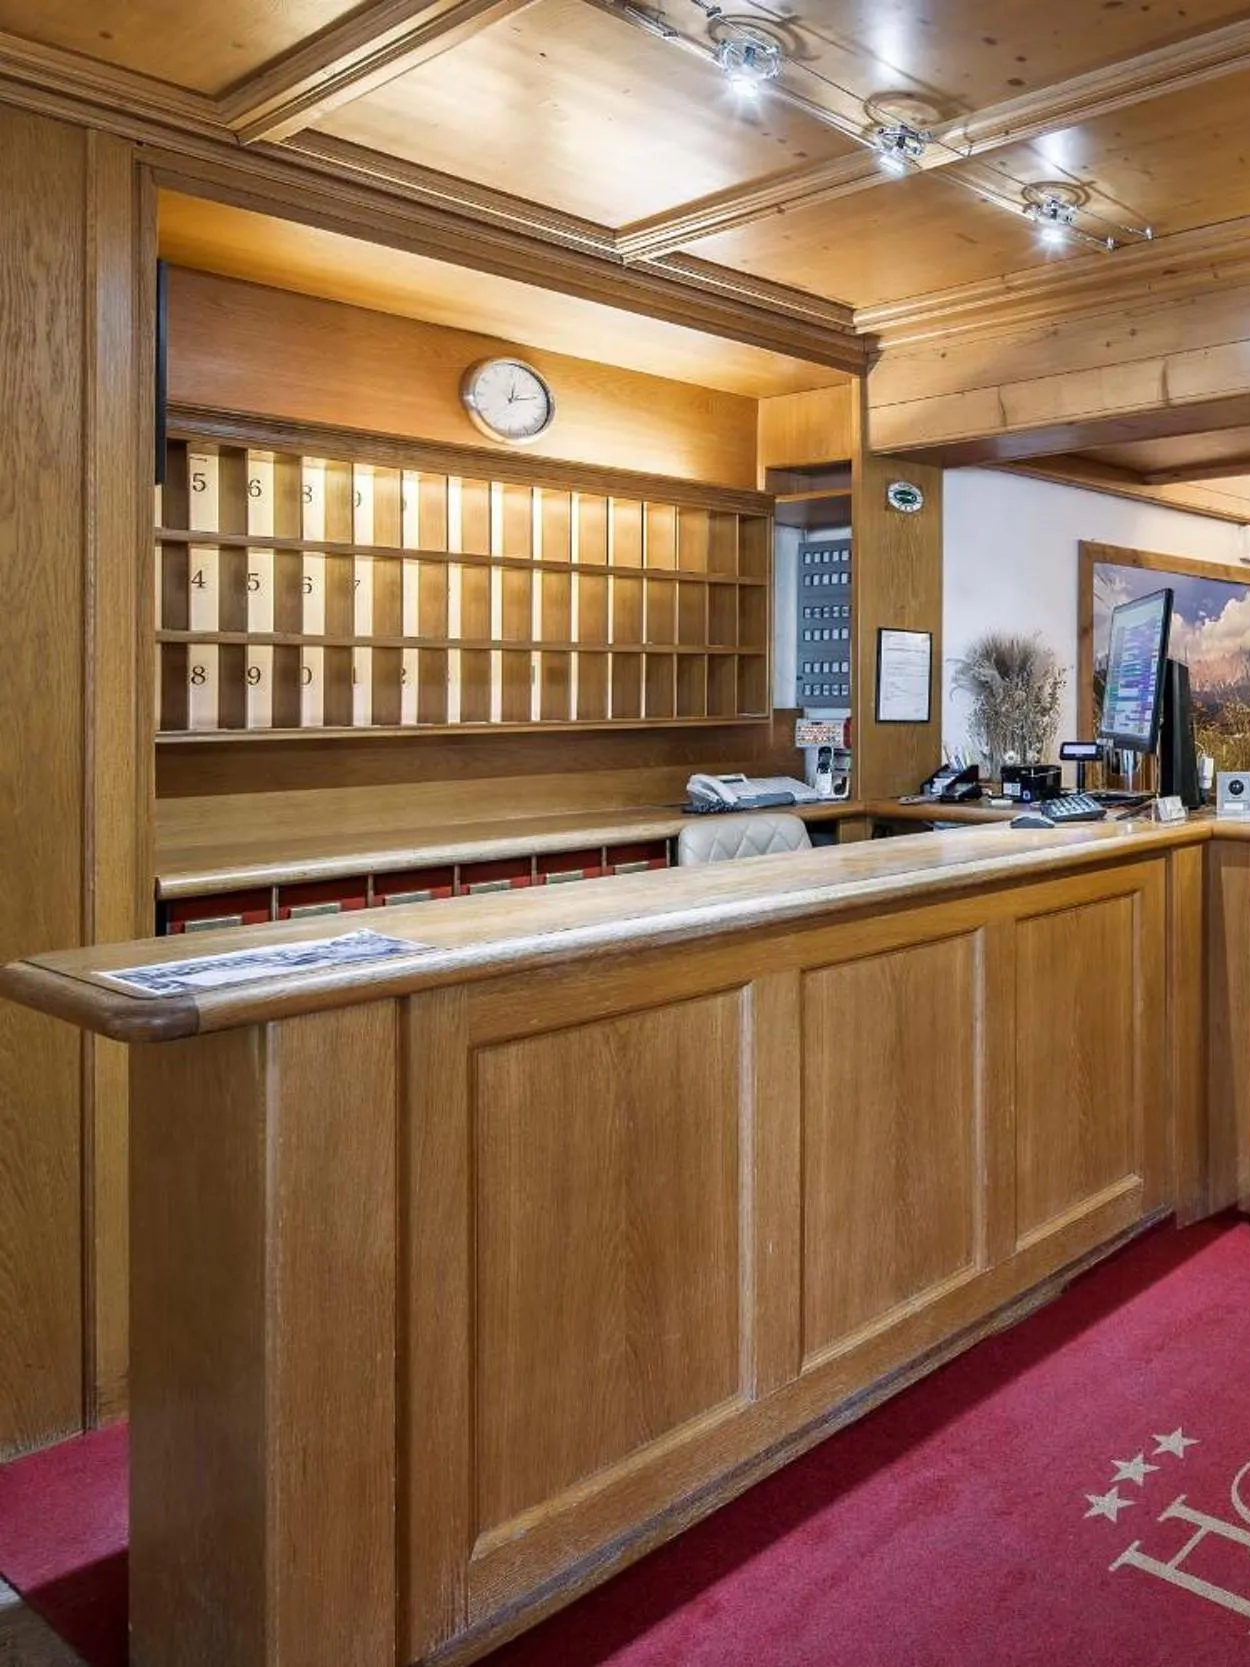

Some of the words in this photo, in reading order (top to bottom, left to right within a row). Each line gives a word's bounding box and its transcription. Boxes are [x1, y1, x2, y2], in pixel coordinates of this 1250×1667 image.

[192, 473, 207, 493] 5
[249, 479, 262, 498] 6
[191, 569, 207, 589] 4
[247, 573, 261, 592] 5
[191, 665, 206, 686] 8
[247, 666, 262, 686] 9
